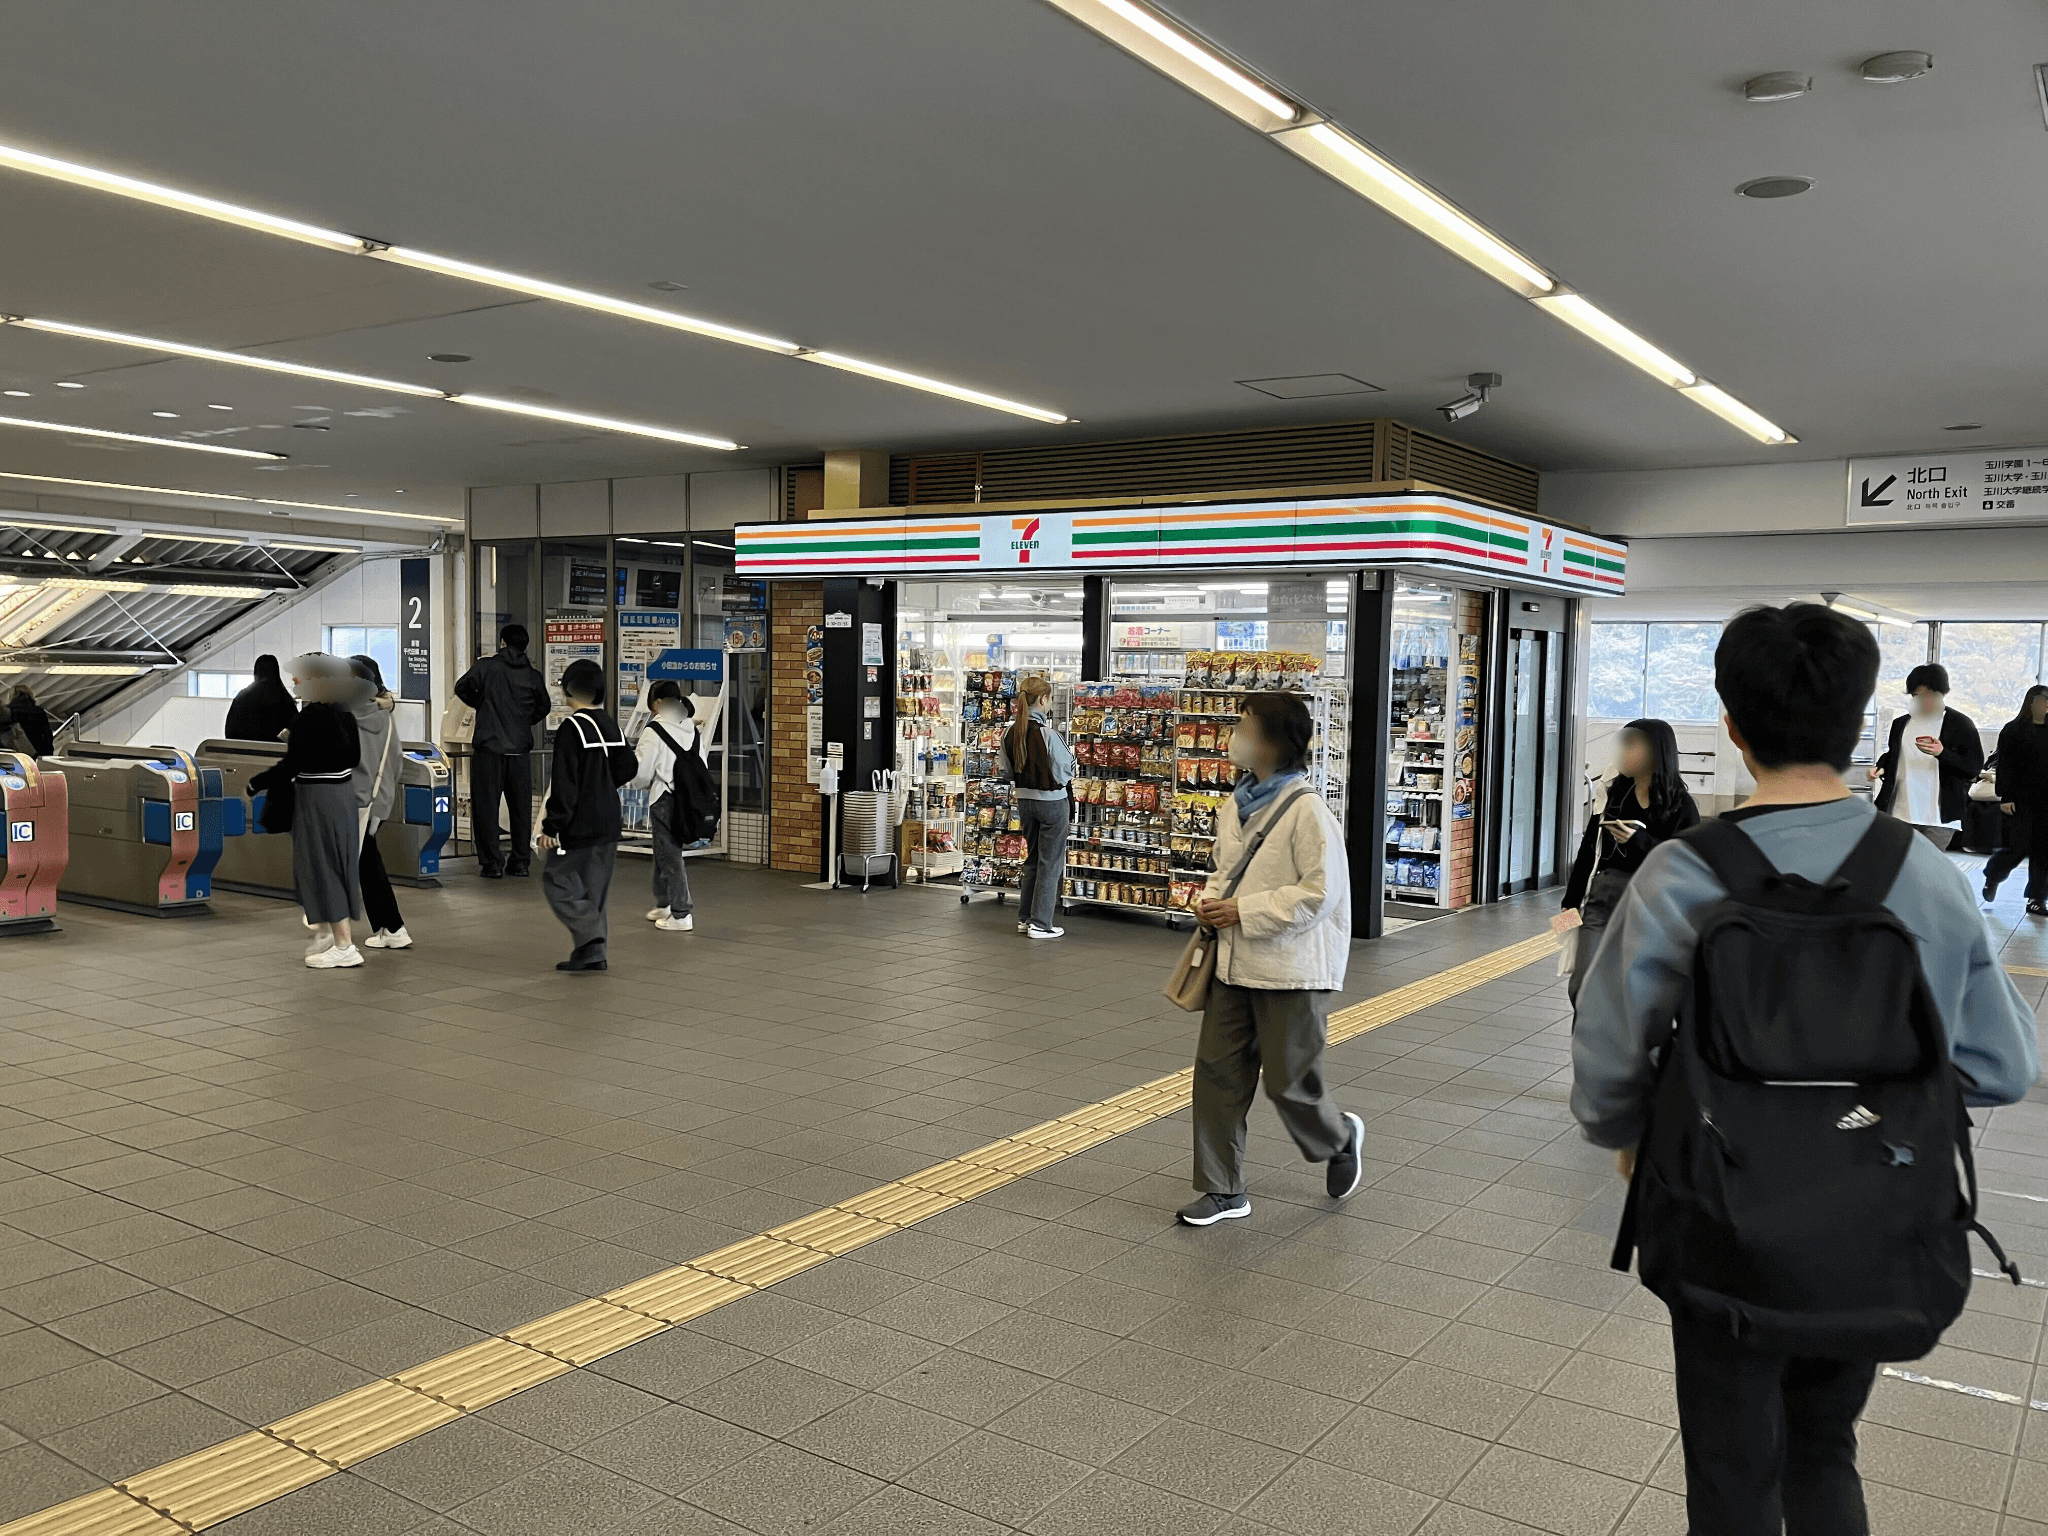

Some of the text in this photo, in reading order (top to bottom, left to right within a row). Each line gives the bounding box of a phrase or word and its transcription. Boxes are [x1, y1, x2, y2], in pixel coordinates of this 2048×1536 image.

[1907, 467, 1947, 483] 北口
[1907, 485, 1968, 500] North Exit
[1996, 500, 2015, 509] 交番
[1012, 518, 1040, 564] 7
[408, 597, 422, 629] 2
[177, 814, 191, 829] IC
[13, 824, 31, 840] IC
